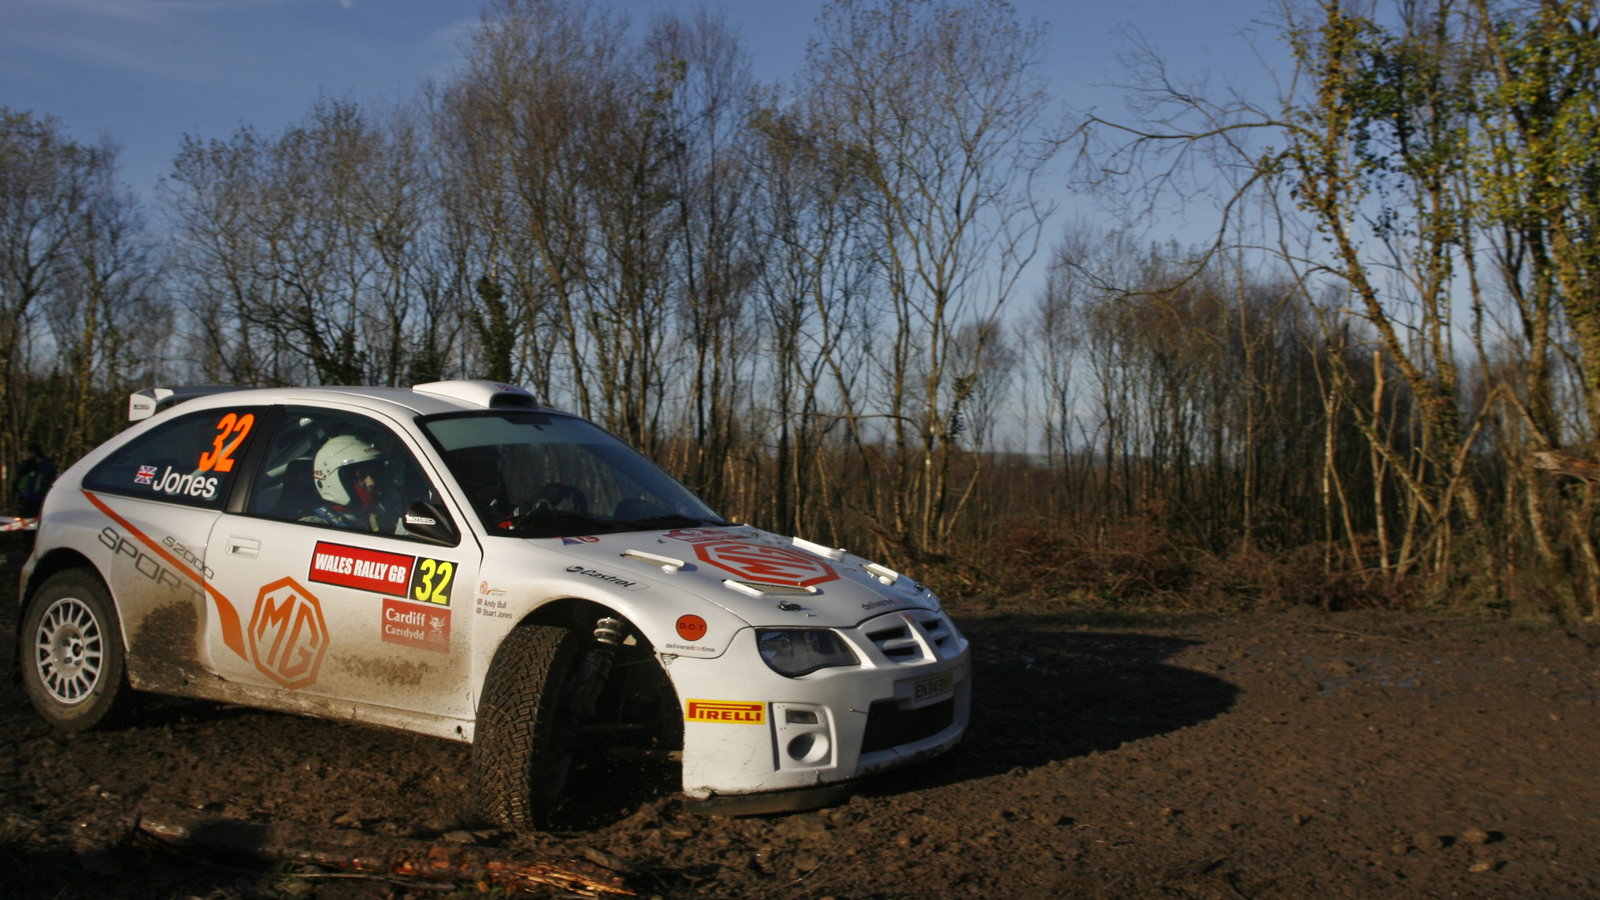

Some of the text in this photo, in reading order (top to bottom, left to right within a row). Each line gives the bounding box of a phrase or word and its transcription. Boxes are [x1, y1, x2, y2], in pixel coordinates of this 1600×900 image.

[198, 412, 254, 472] 32
[152, 466, 218, 498] Jones
[98, 527, 206, 600] SPORT
[162, 535, 215, 580] S2000
[314, 552, 407, 584] WALES RALLY GB
[415, 558, 453, 605] 32
[580, 569, 637, 588] Castrol
[385, 607, 427, 627] Cardiff
[482, 608, 513, 619] Stuart Jones
[483, 599, 507, 609] Andy Bull
[256, 593, 321, 679] MG
[385, 624, 425, 641] Caerdydd
[688, 702, 763, 722] PIRELLI
